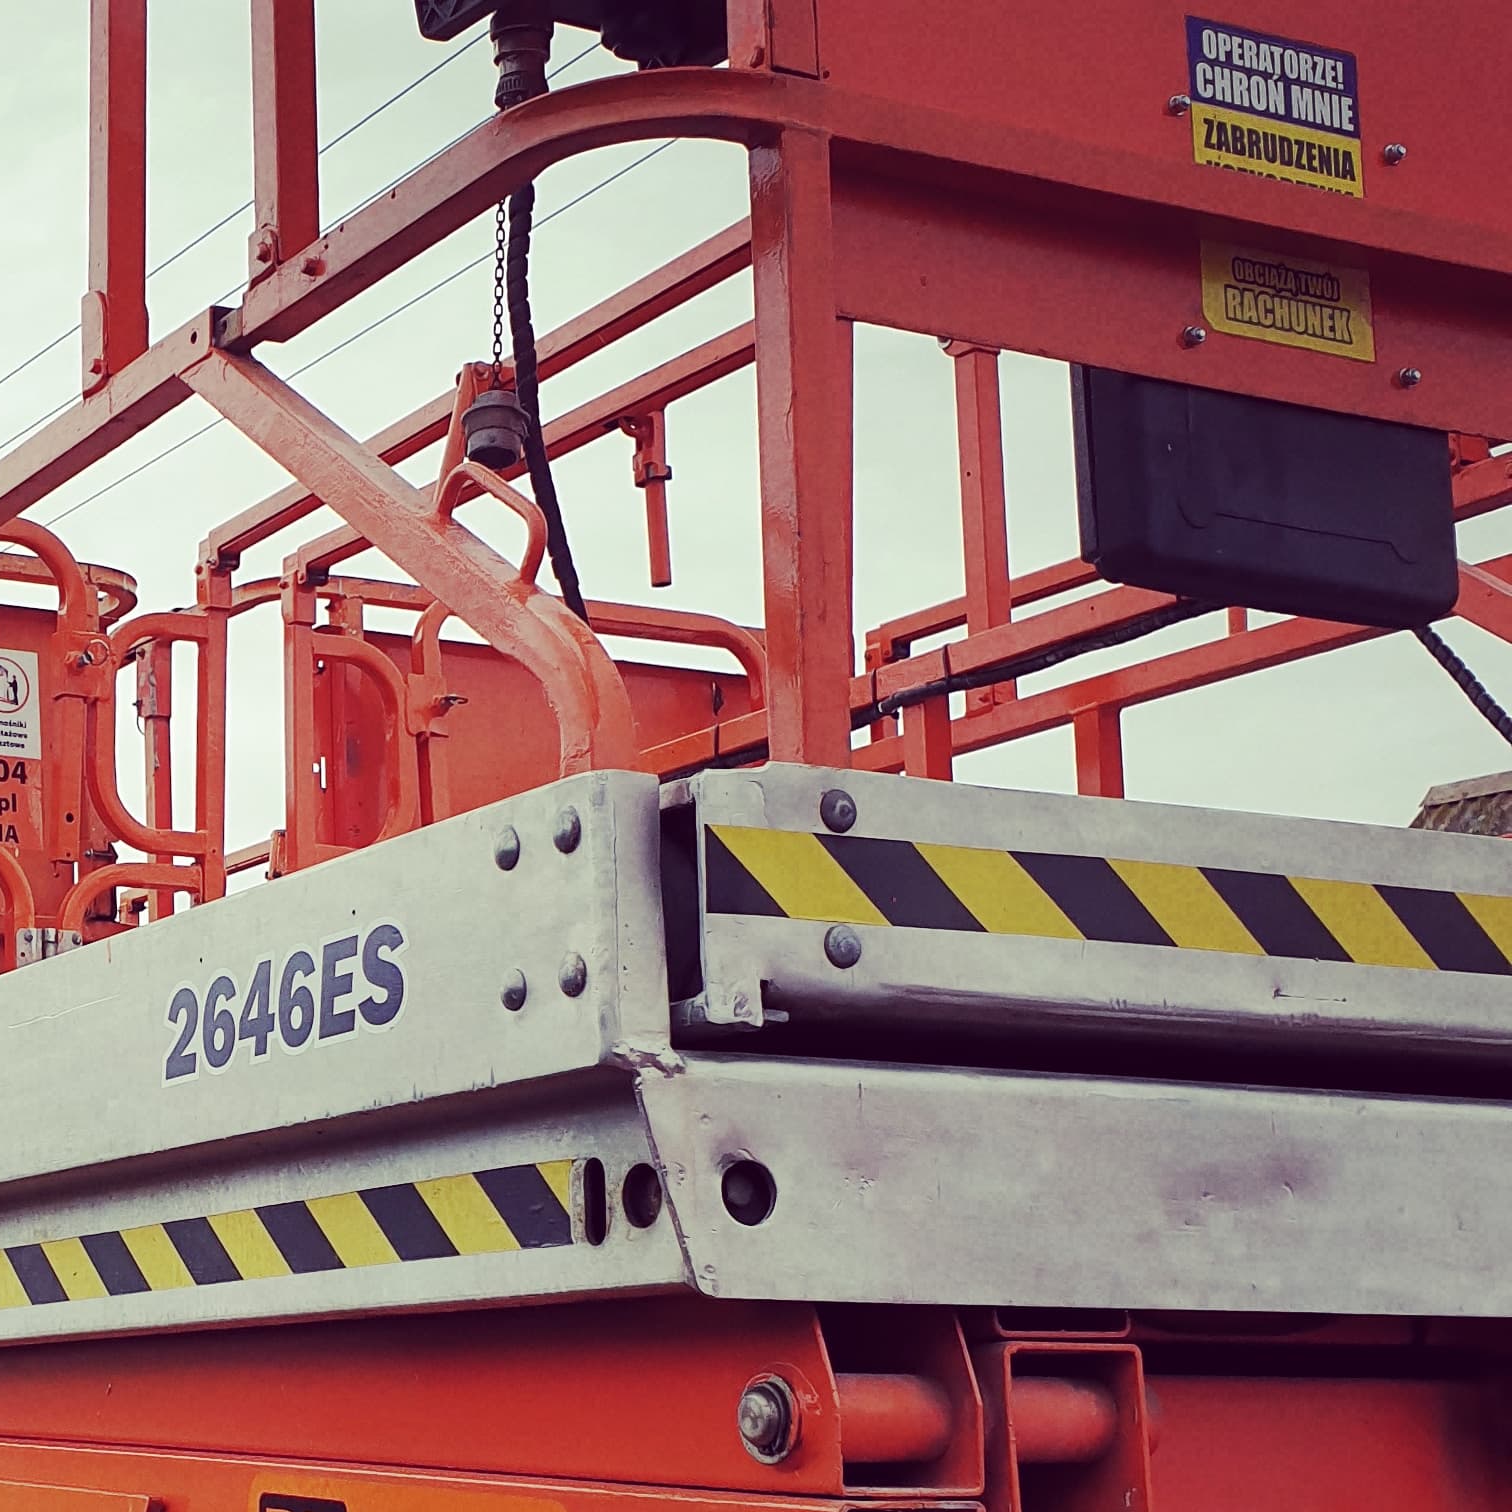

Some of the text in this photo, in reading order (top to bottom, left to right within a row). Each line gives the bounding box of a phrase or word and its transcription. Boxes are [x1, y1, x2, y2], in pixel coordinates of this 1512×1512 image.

[1202, 29, 1344, 91] OPERATORZE!
[1196, 62, 1355, 132] CHROŃ MNIE
[1203, 117, 1356, 182] ZABRUDZENIA
[1225, 284, 1352, 345] RACHUNEK
[165, 924, 405, 1080] 2646ES
